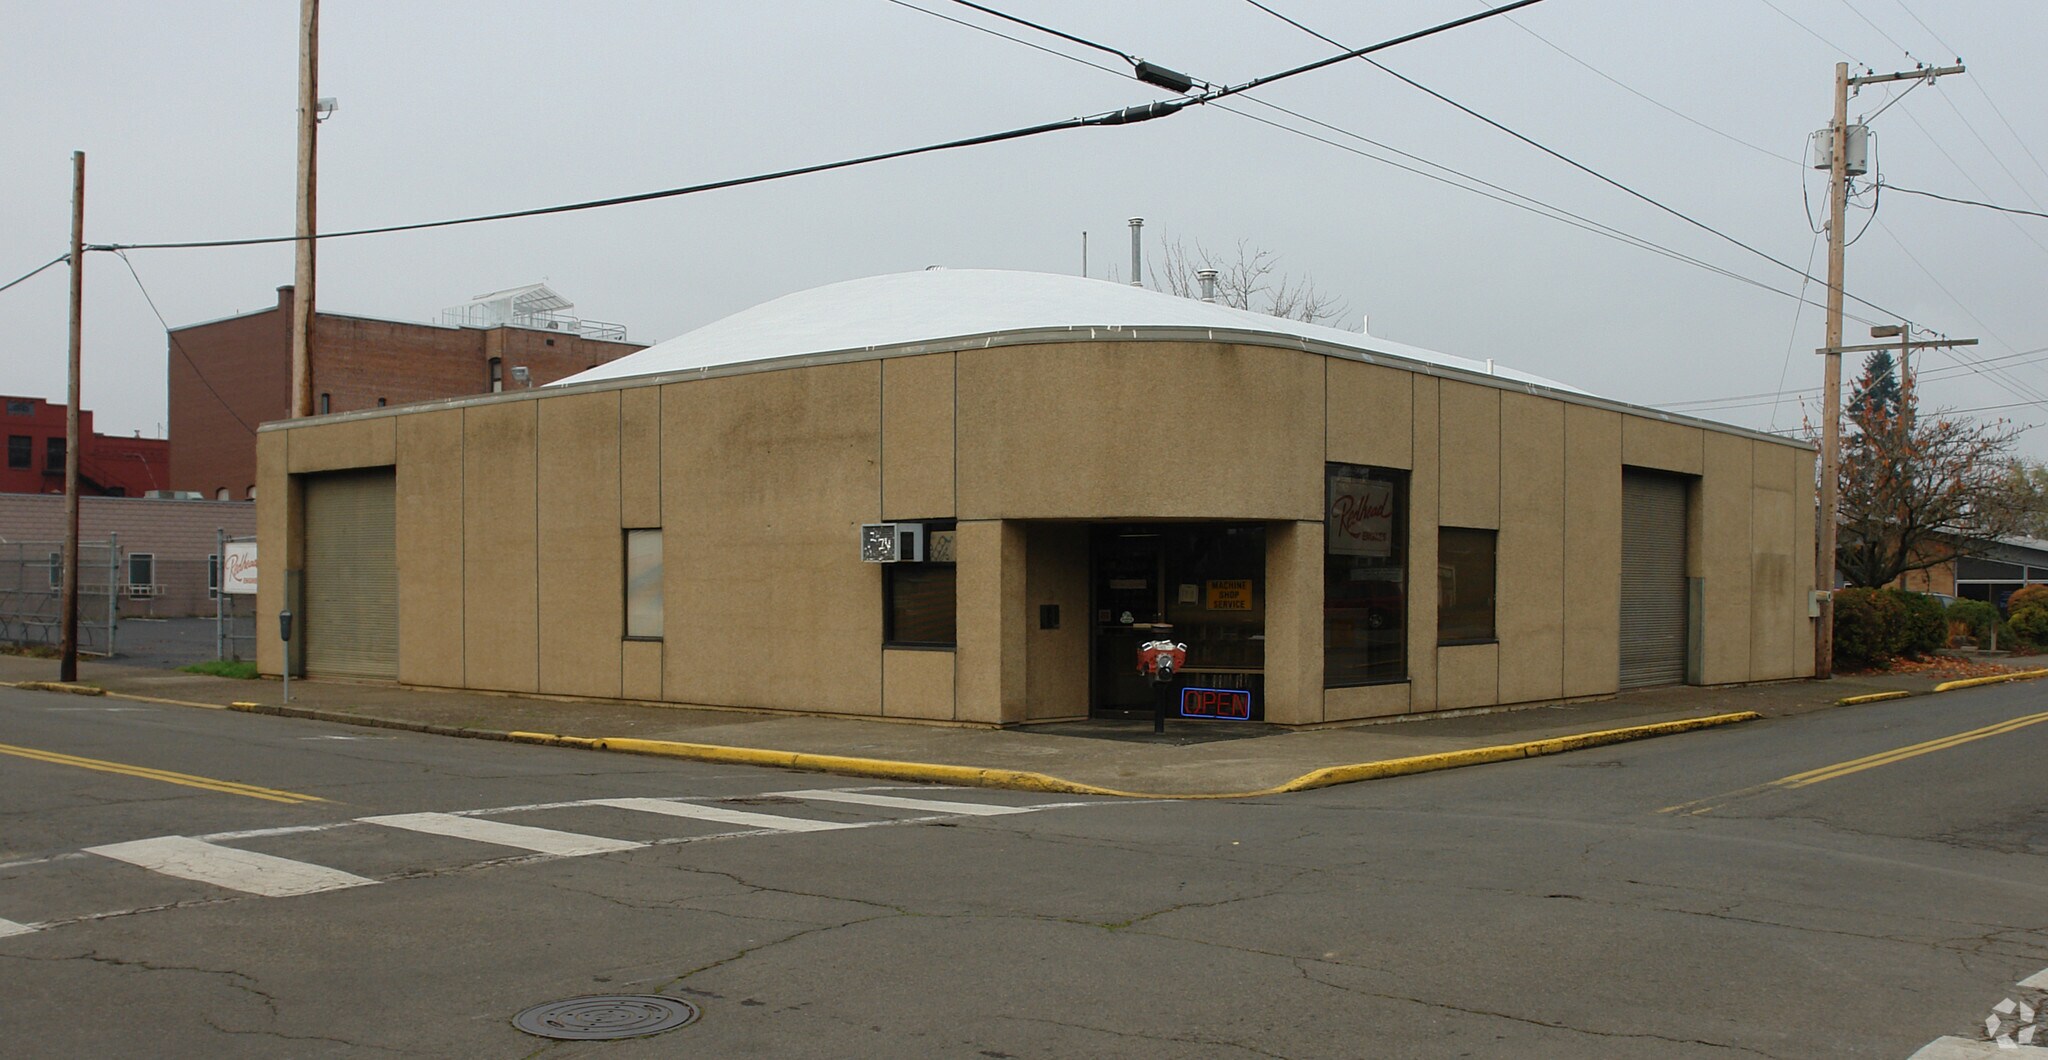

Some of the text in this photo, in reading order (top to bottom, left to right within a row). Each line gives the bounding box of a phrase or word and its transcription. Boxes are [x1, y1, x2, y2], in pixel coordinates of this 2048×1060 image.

[1331, 491, 1393, 539] Redhead
[225, 552, 257, 582] Redhea
[1211, 581, 1247, 590] MACHINE
[1218, 590, 1240, 599] SHOP
[1213, 600, 1246, 609] SERVICE
[1184, 690, 1249, 717] OPEN
